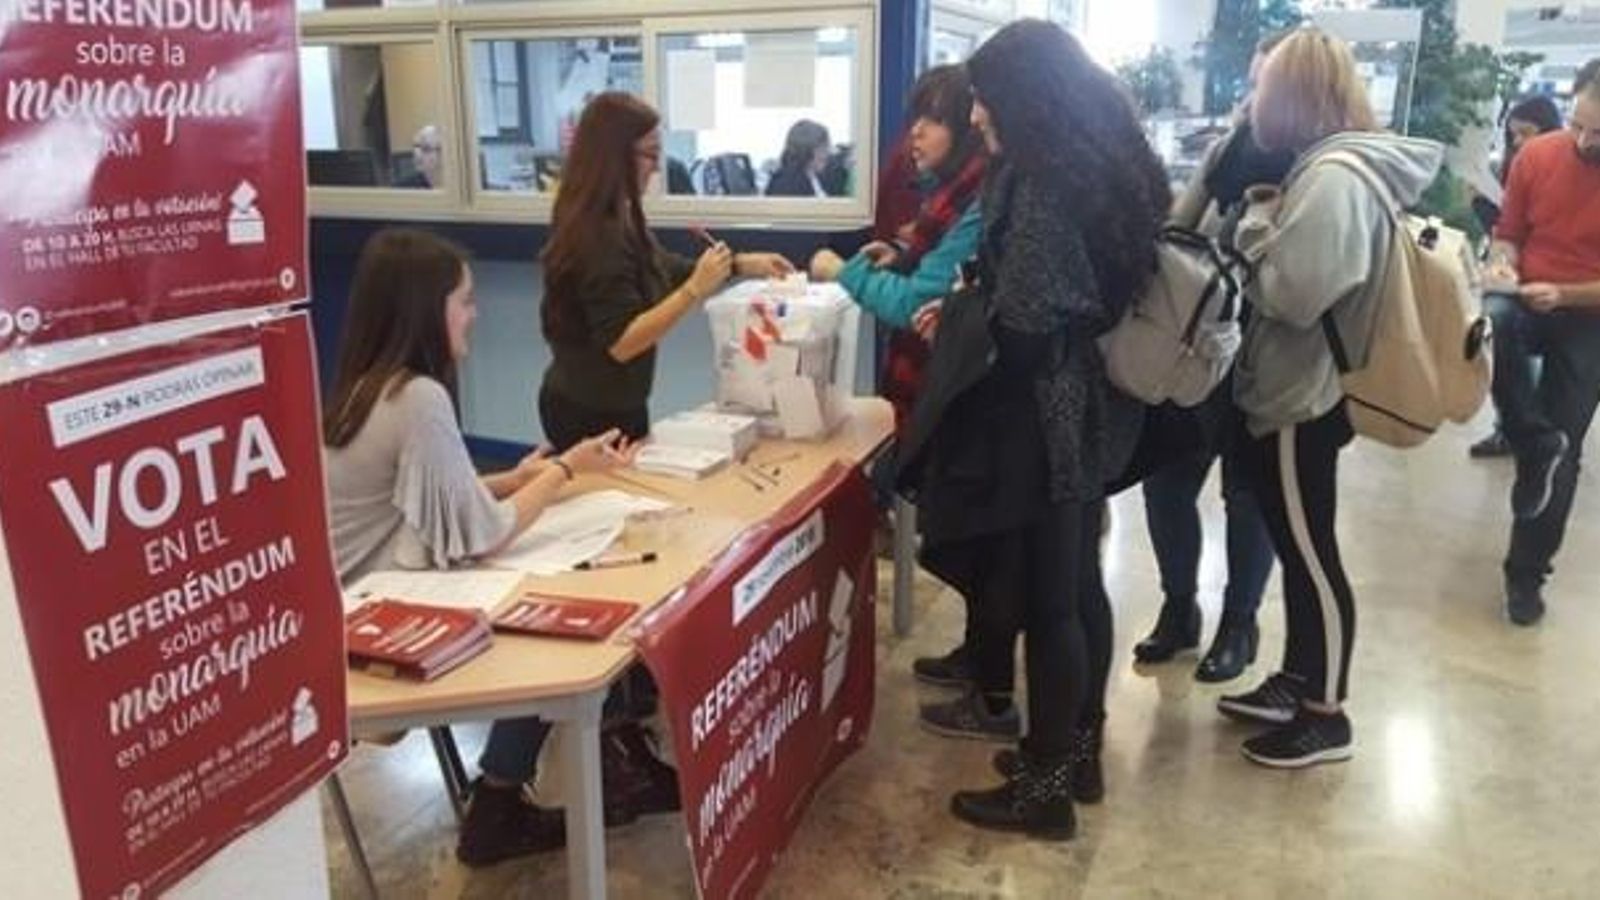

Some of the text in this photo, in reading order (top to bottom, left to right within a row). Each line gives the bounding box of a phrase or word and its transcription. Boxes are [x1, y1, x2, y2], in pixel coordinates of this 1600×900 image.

[76, 35, 186, 66] sobre la
[103, 131, 142, 158] AM
[64, 406, 100, 431] ESTE
[102, 394, 141, 419] 29-N
[49, 414, 287, 553] VOTA
[143, 516, 230, 576] EN EL
[83, 536, 296, 661] REFERÉNDUM
[160, 599, 250, 660] sobre la
[109, 603, 304, 735] monarquía
[692, 590, 818, 751] REFERÉNDUM
[116, 692, 222, 768] en la UAM
